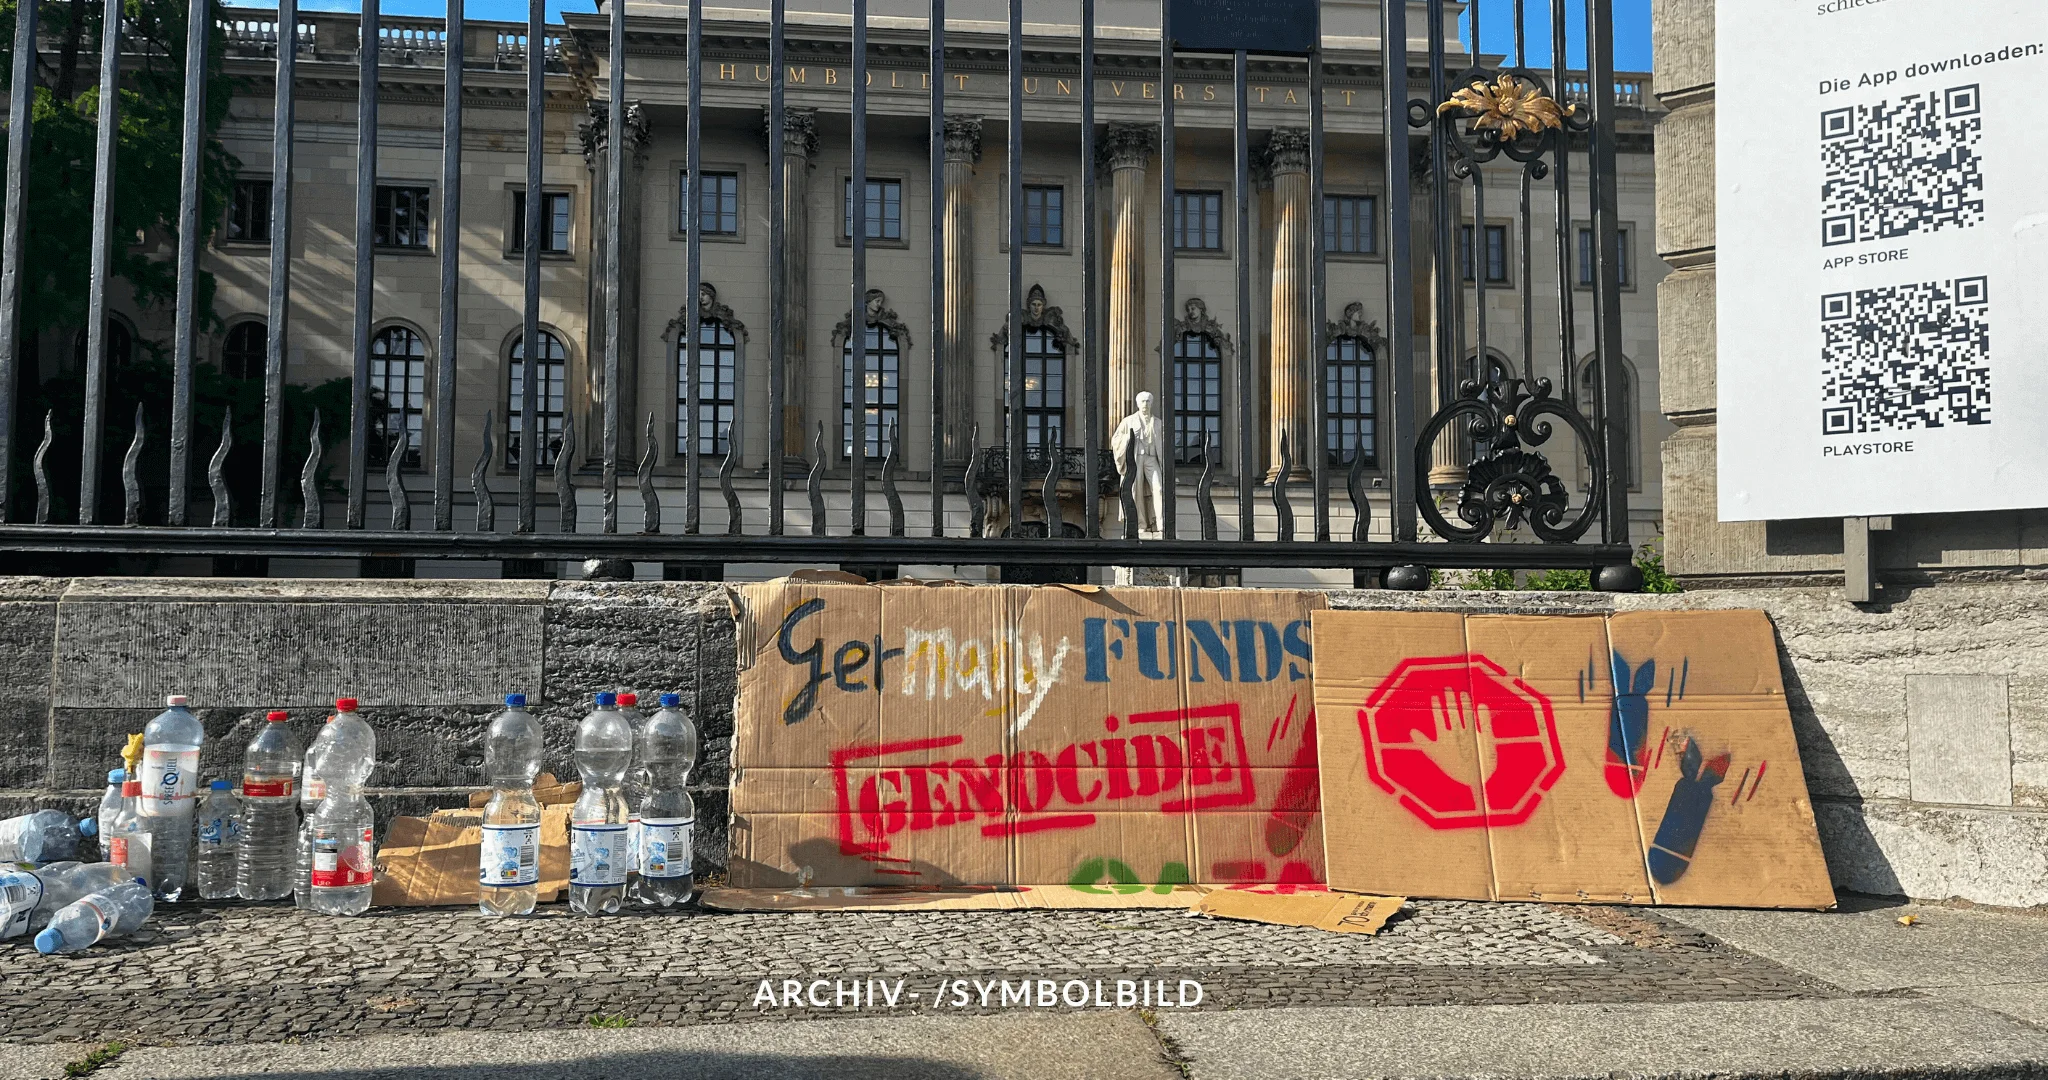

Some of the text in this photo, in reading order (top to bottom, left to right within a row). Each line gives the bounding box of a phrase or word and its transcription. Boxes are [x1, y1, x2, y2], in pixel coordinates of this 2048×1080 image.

[1819, 43, 2044, 95] Die App downloaden:
[1823, 248, 1909, 270] APP STORE
[1823, 440, 1914, 457] PLAYSTORE
[1083, 616, 1314, 682] FUNDS
